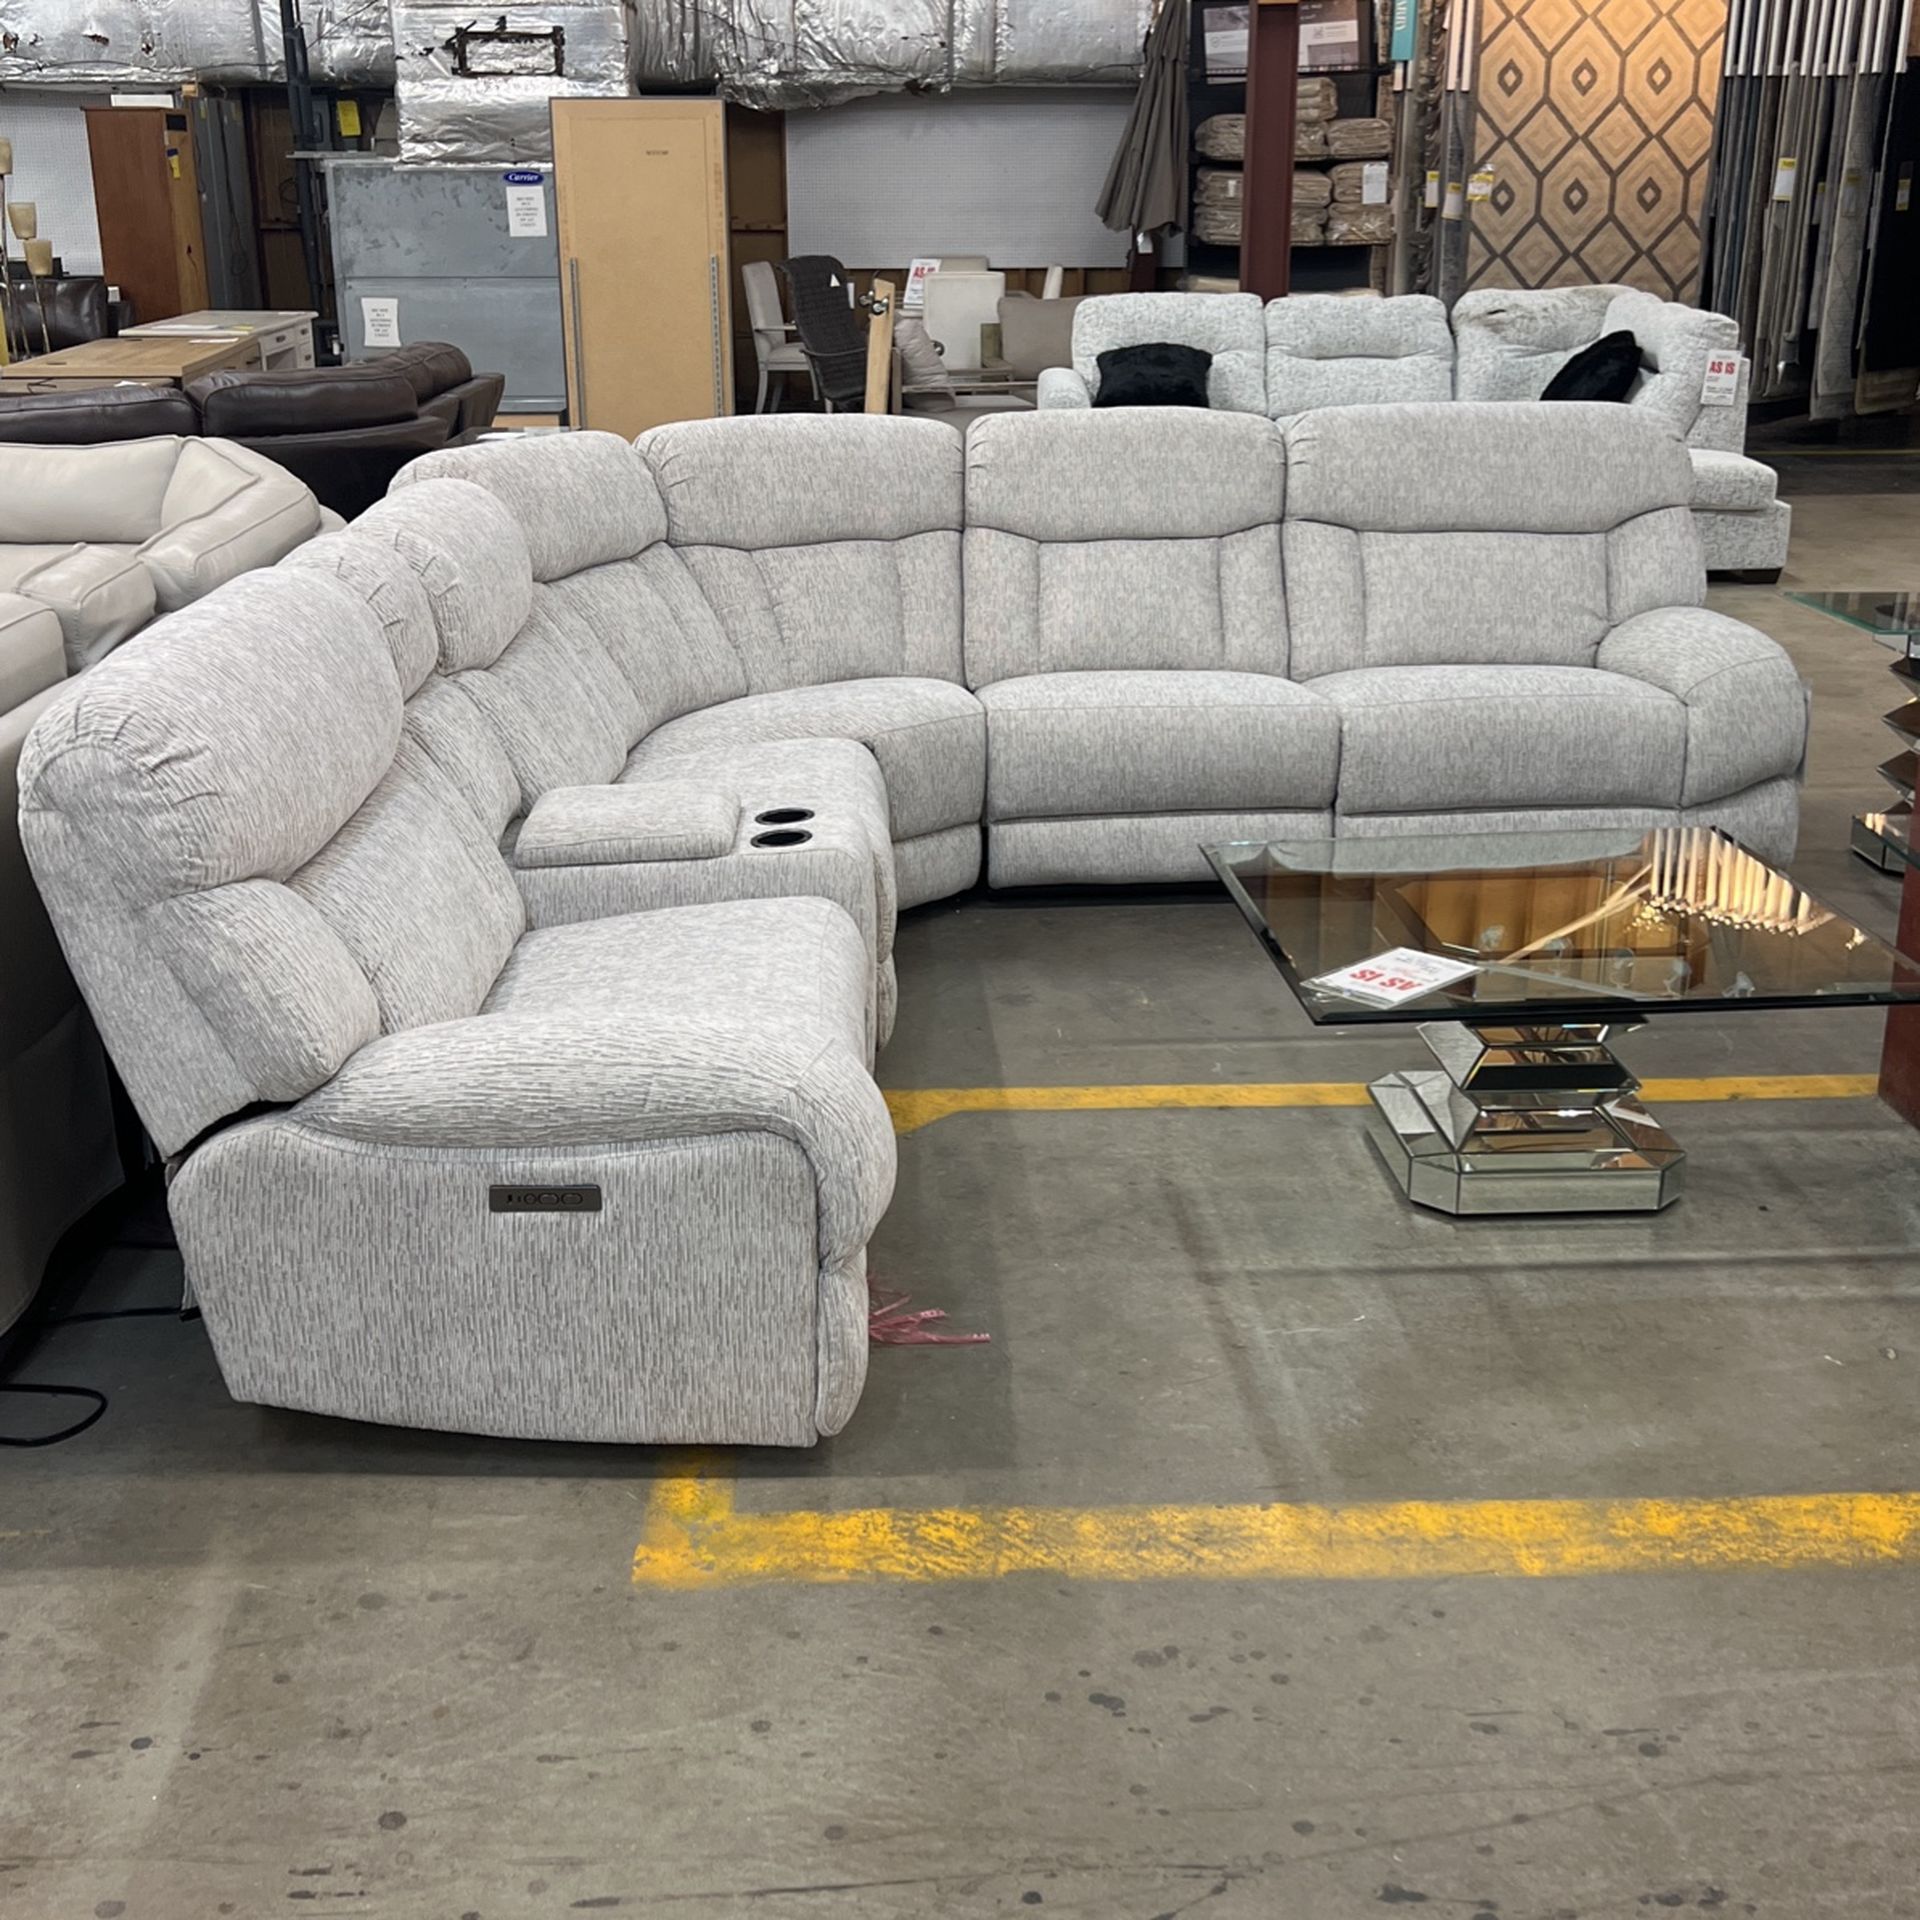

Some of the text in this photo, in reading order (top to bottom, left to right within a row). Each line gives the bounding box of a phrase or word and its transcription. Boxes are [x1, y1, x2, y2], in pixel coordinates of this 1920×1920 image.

[508, 172, 540, 182] Carrier
[1709, 361, 1736, 375] AS IS
[1350, 968, 1425, 991] AS IS
